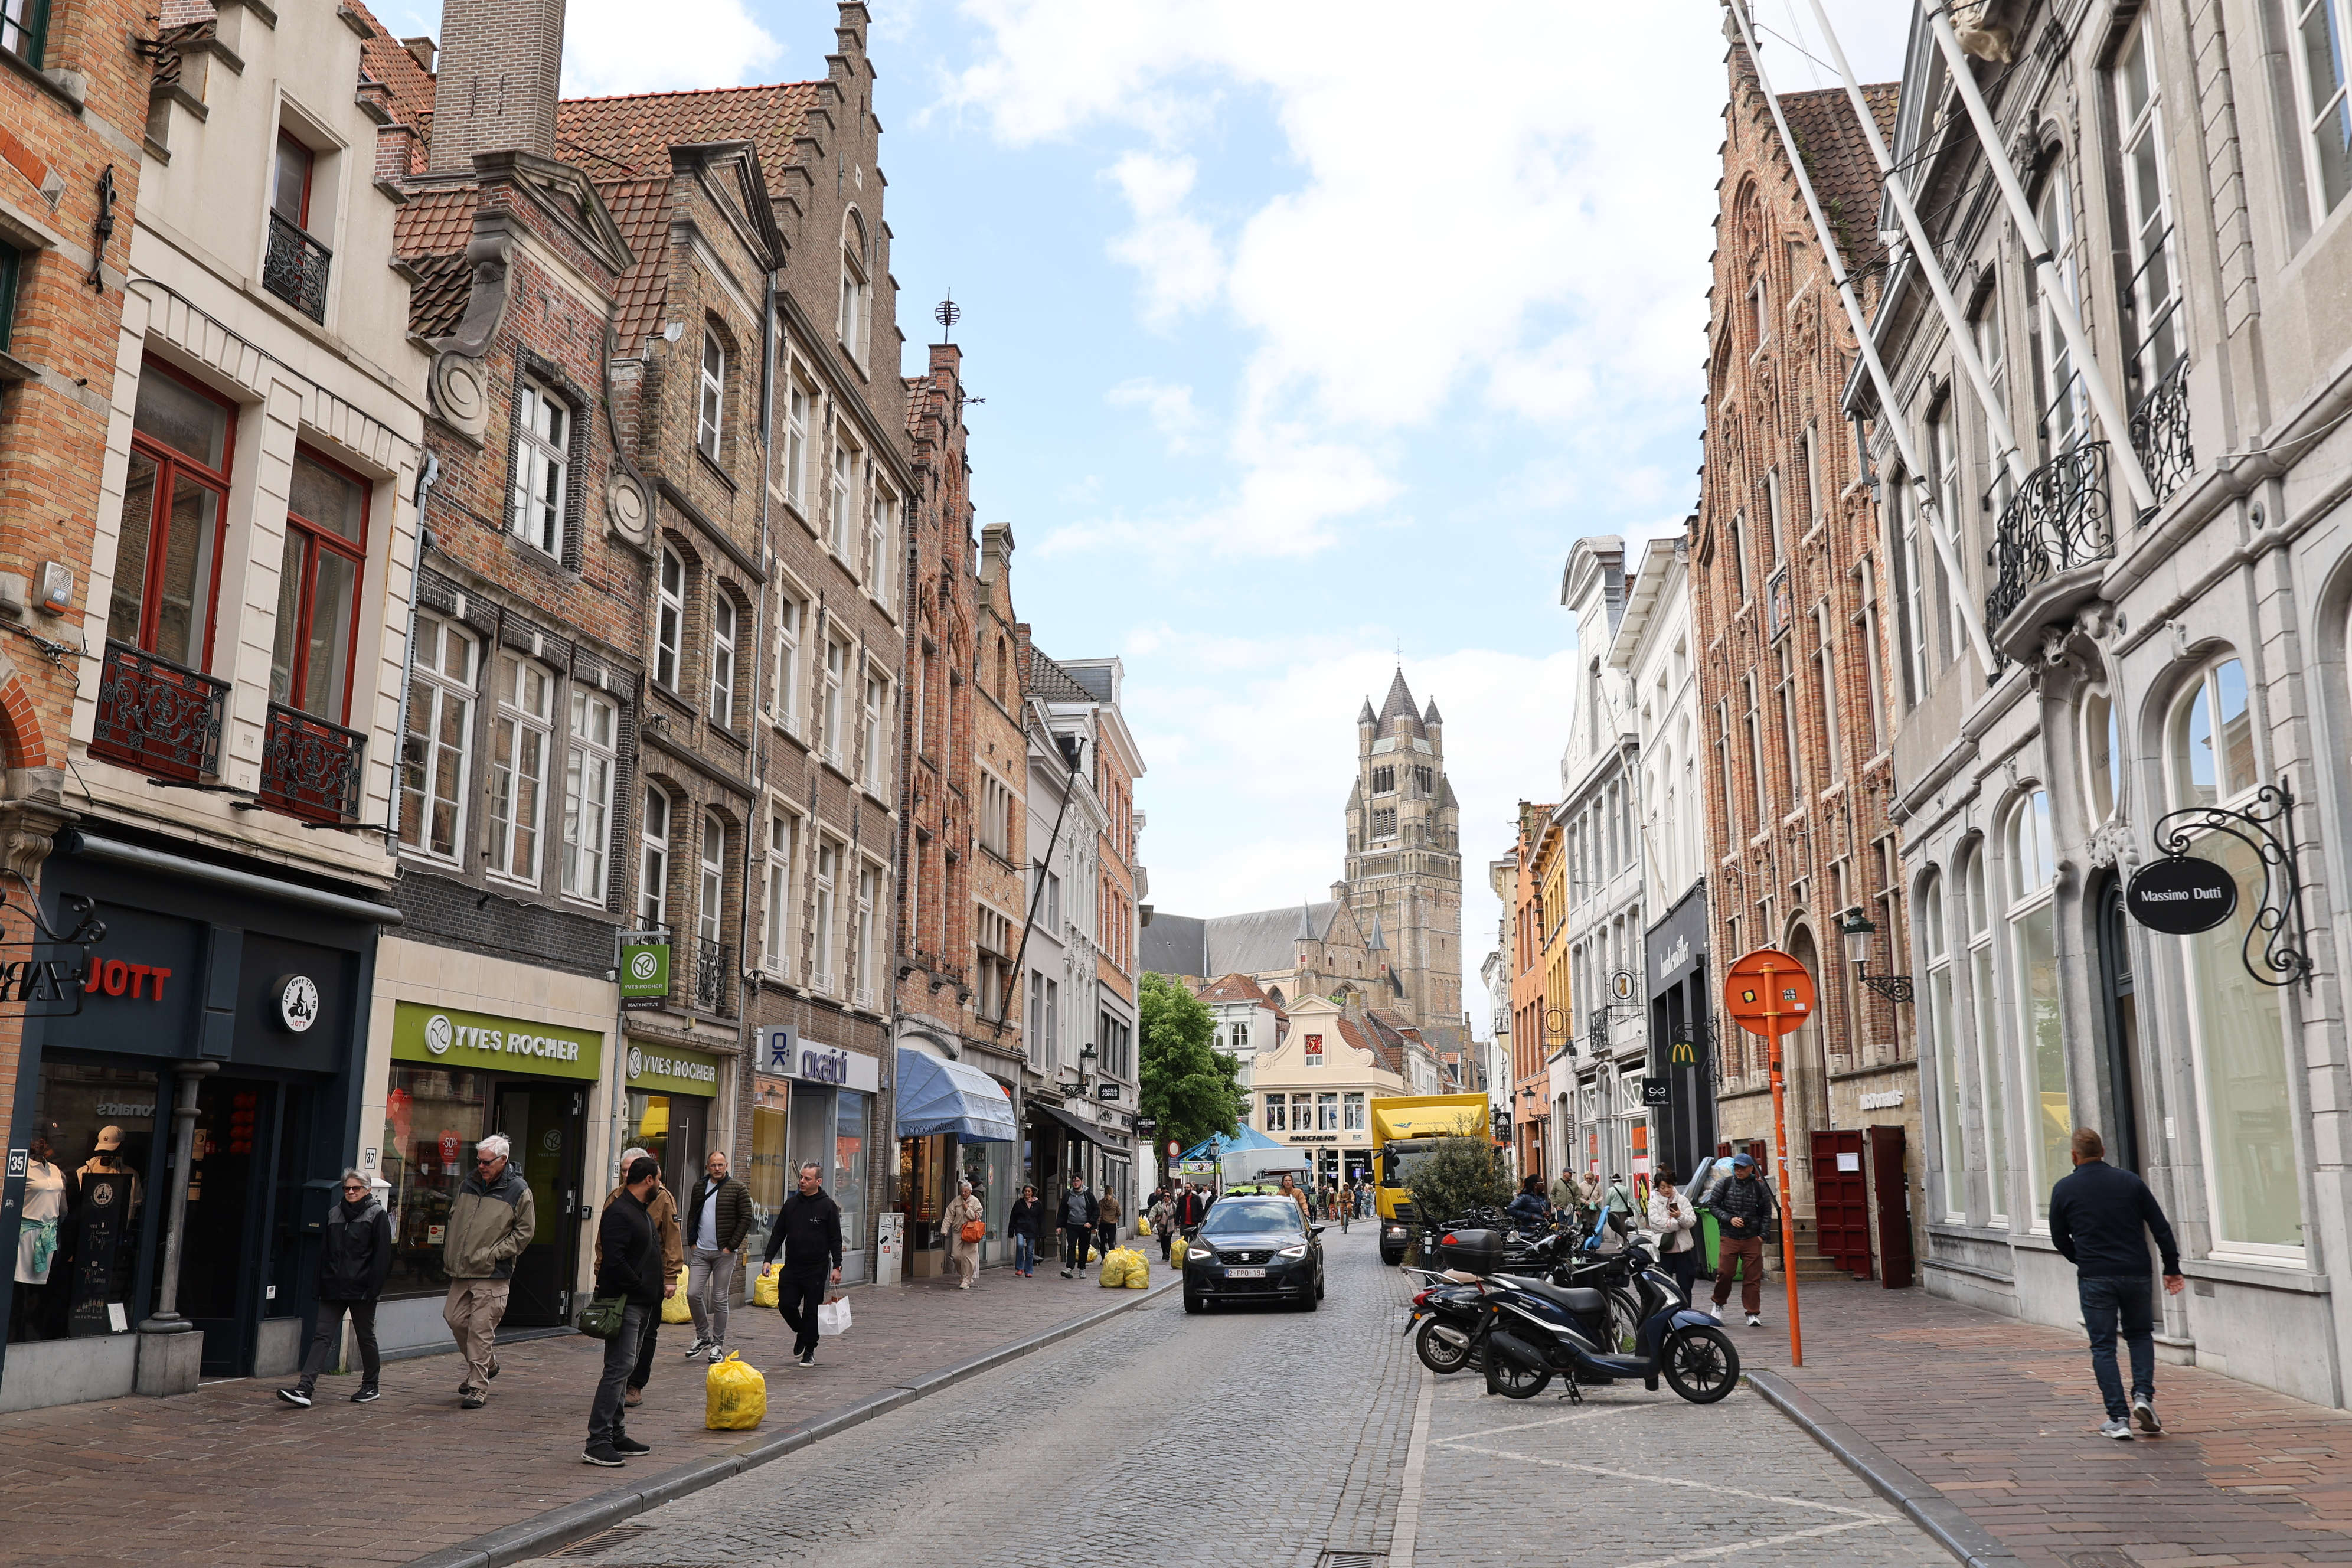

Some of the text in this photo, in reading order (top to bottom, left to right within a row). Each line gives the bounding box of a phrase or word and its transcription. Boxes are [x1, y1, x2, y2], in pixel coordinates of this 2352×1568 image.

[2141, 887, 2222, 902] Massimo Dutti
[85, 956, 172, 1001] JOTT
[283, 987, 292, 1005] Just
[291, 978, 304, 987] Over
[306, 979, 315, 992] The
[453, 1025, 579, 1061] YVES ROCHER
[642, 1055, 715, 1082] YVES ROCHER
[909, 1122, 955, 1135] chocolates
[443, 1137, 458, 1148] -50%
[11, 1156, 24, 1171] 35
[366, 1152, 375, 1164] 37
